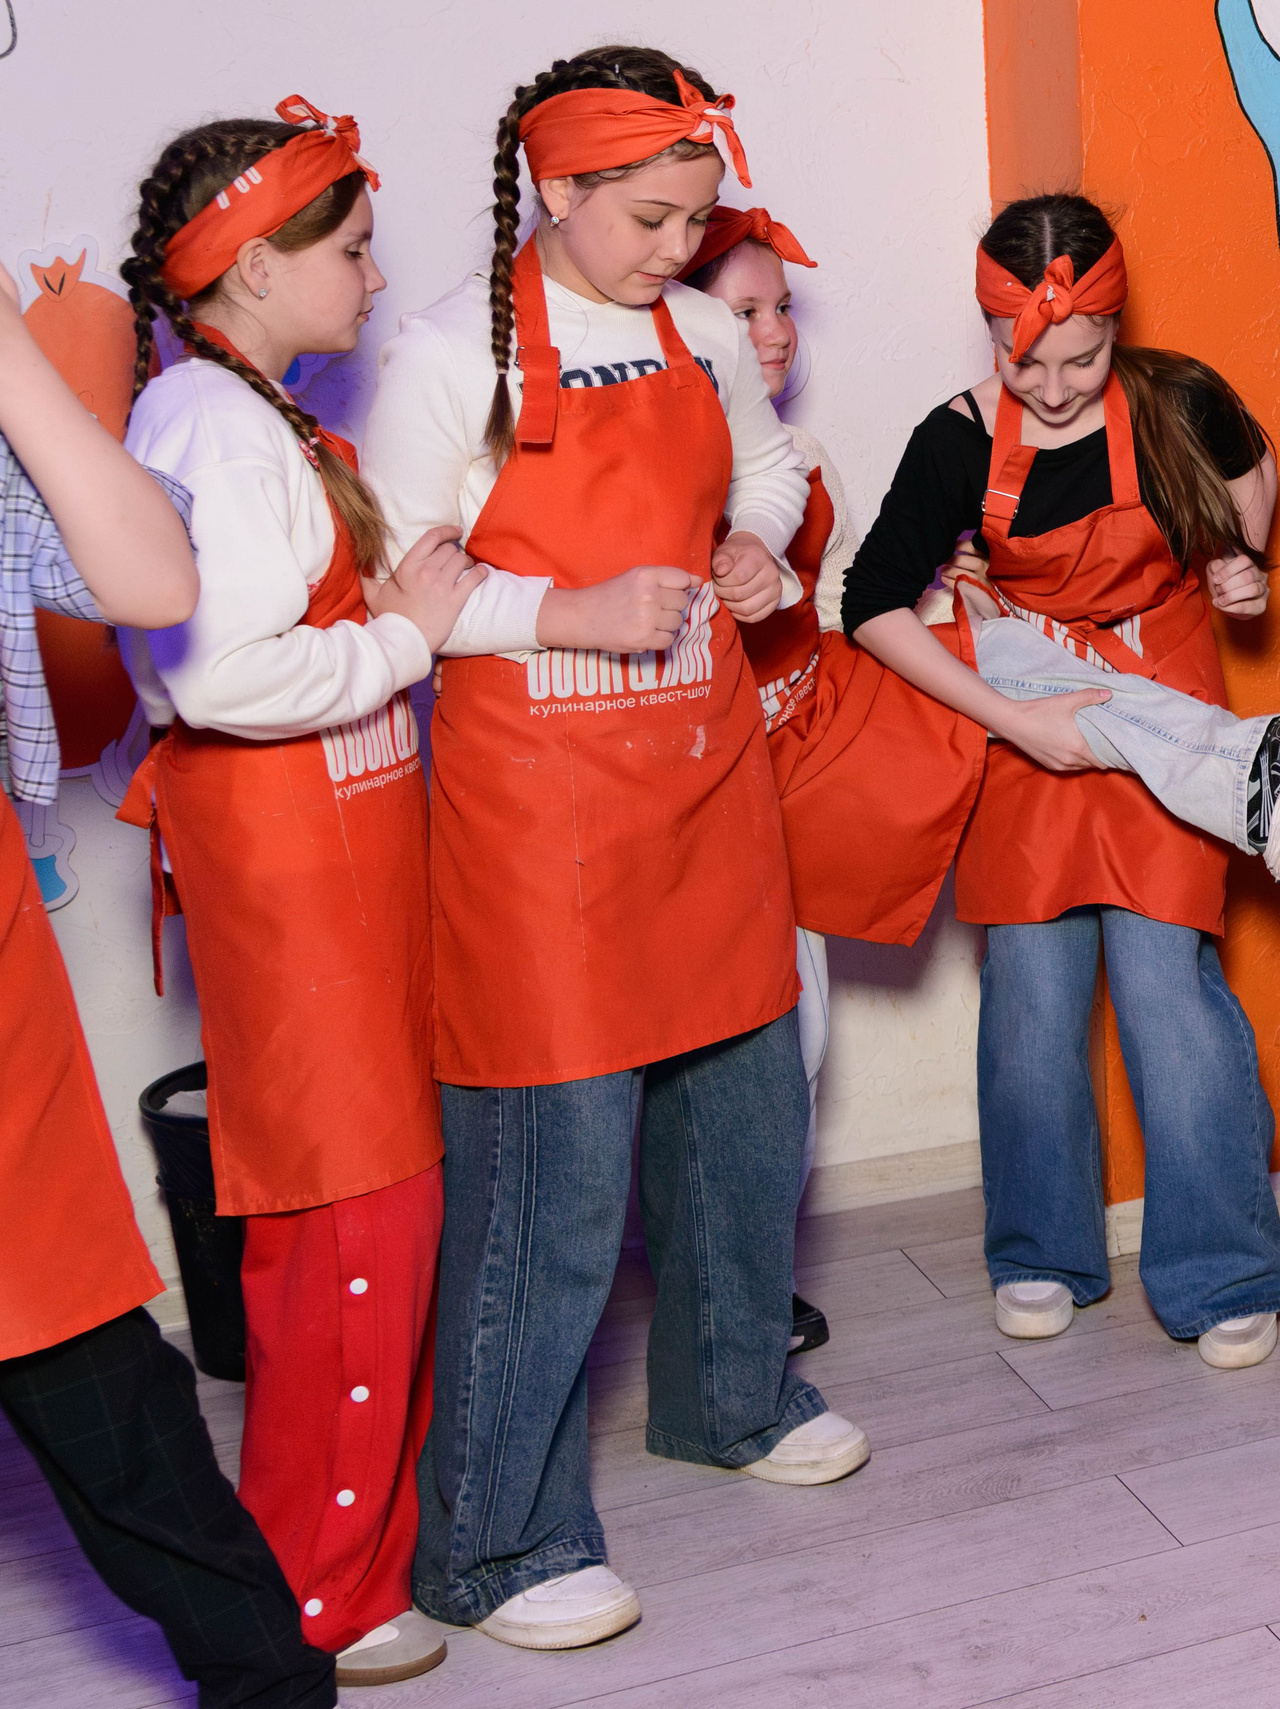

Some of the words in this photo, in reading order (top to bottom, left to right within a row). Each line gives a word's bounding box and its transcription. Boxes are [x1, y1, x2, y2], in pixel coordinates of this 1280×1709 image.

[529, 694, 637, 718] кулинарное
[639, 684, 712, 707] квест-шоу
[334, 766, 405, 801] кулинарное
